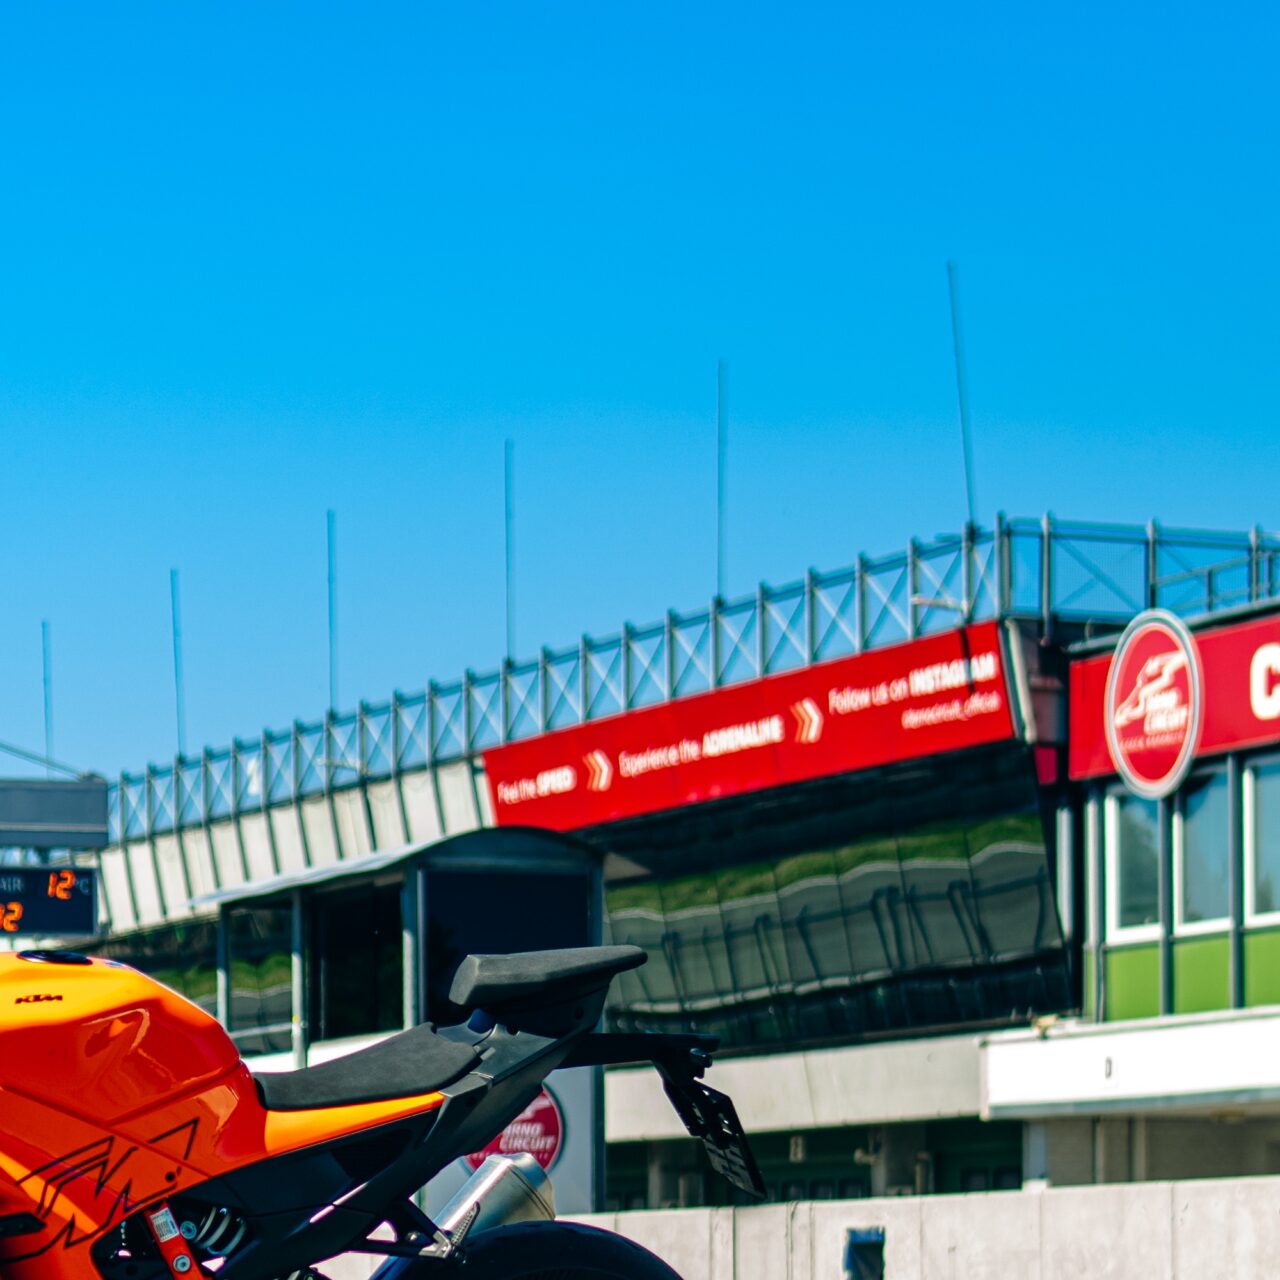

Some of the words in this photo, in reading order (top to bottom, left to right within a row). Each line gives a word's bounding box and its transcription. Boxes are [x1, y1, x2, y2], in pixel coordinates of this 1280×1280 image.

[828, 687, 871, 715] Follow
[872, 682, 888, 706] us
[889, 677, 909, 702] on
[619, 744, 680, 778] Experience
[679, 738, 701, 763] the
[702, 714, 785, 758] ADRENALINE
[497, 781, 520, 805] Feel
[520, 777, 537, 800] the
[536, 765, 576, 796] SPEED
[47, 869, 75, 899] 12
[14, 993, 63, 1005] KTM
[499, 1134, 554, 1152] CIRCUIT
